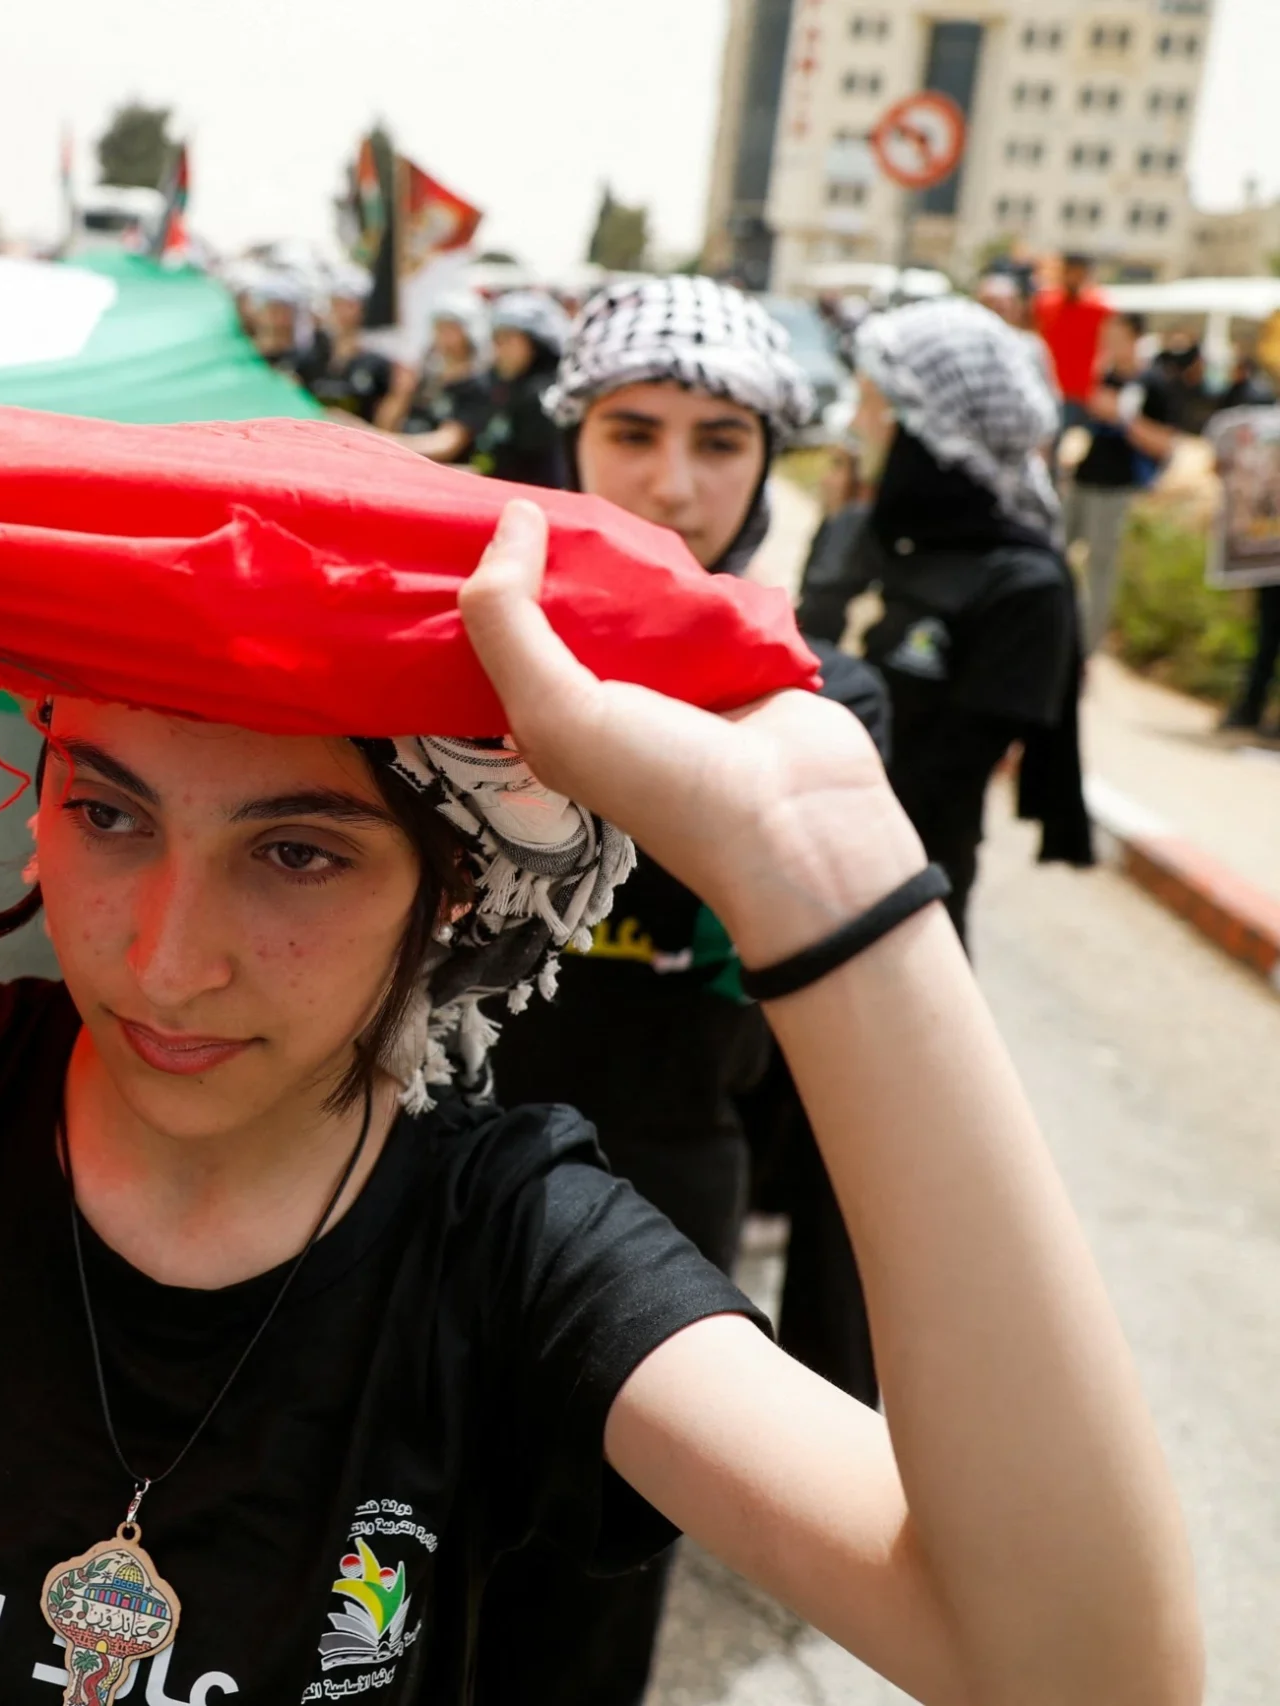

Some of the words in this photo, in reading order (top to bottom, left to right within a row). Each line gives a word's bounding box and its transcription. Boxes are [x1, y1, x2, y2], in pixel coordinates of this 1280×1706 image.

[381, 1498, 413, 1516] دولة
[375, 1517, 416, 1535] التربية
[323, 1674, 371, 1700] الأساسية
